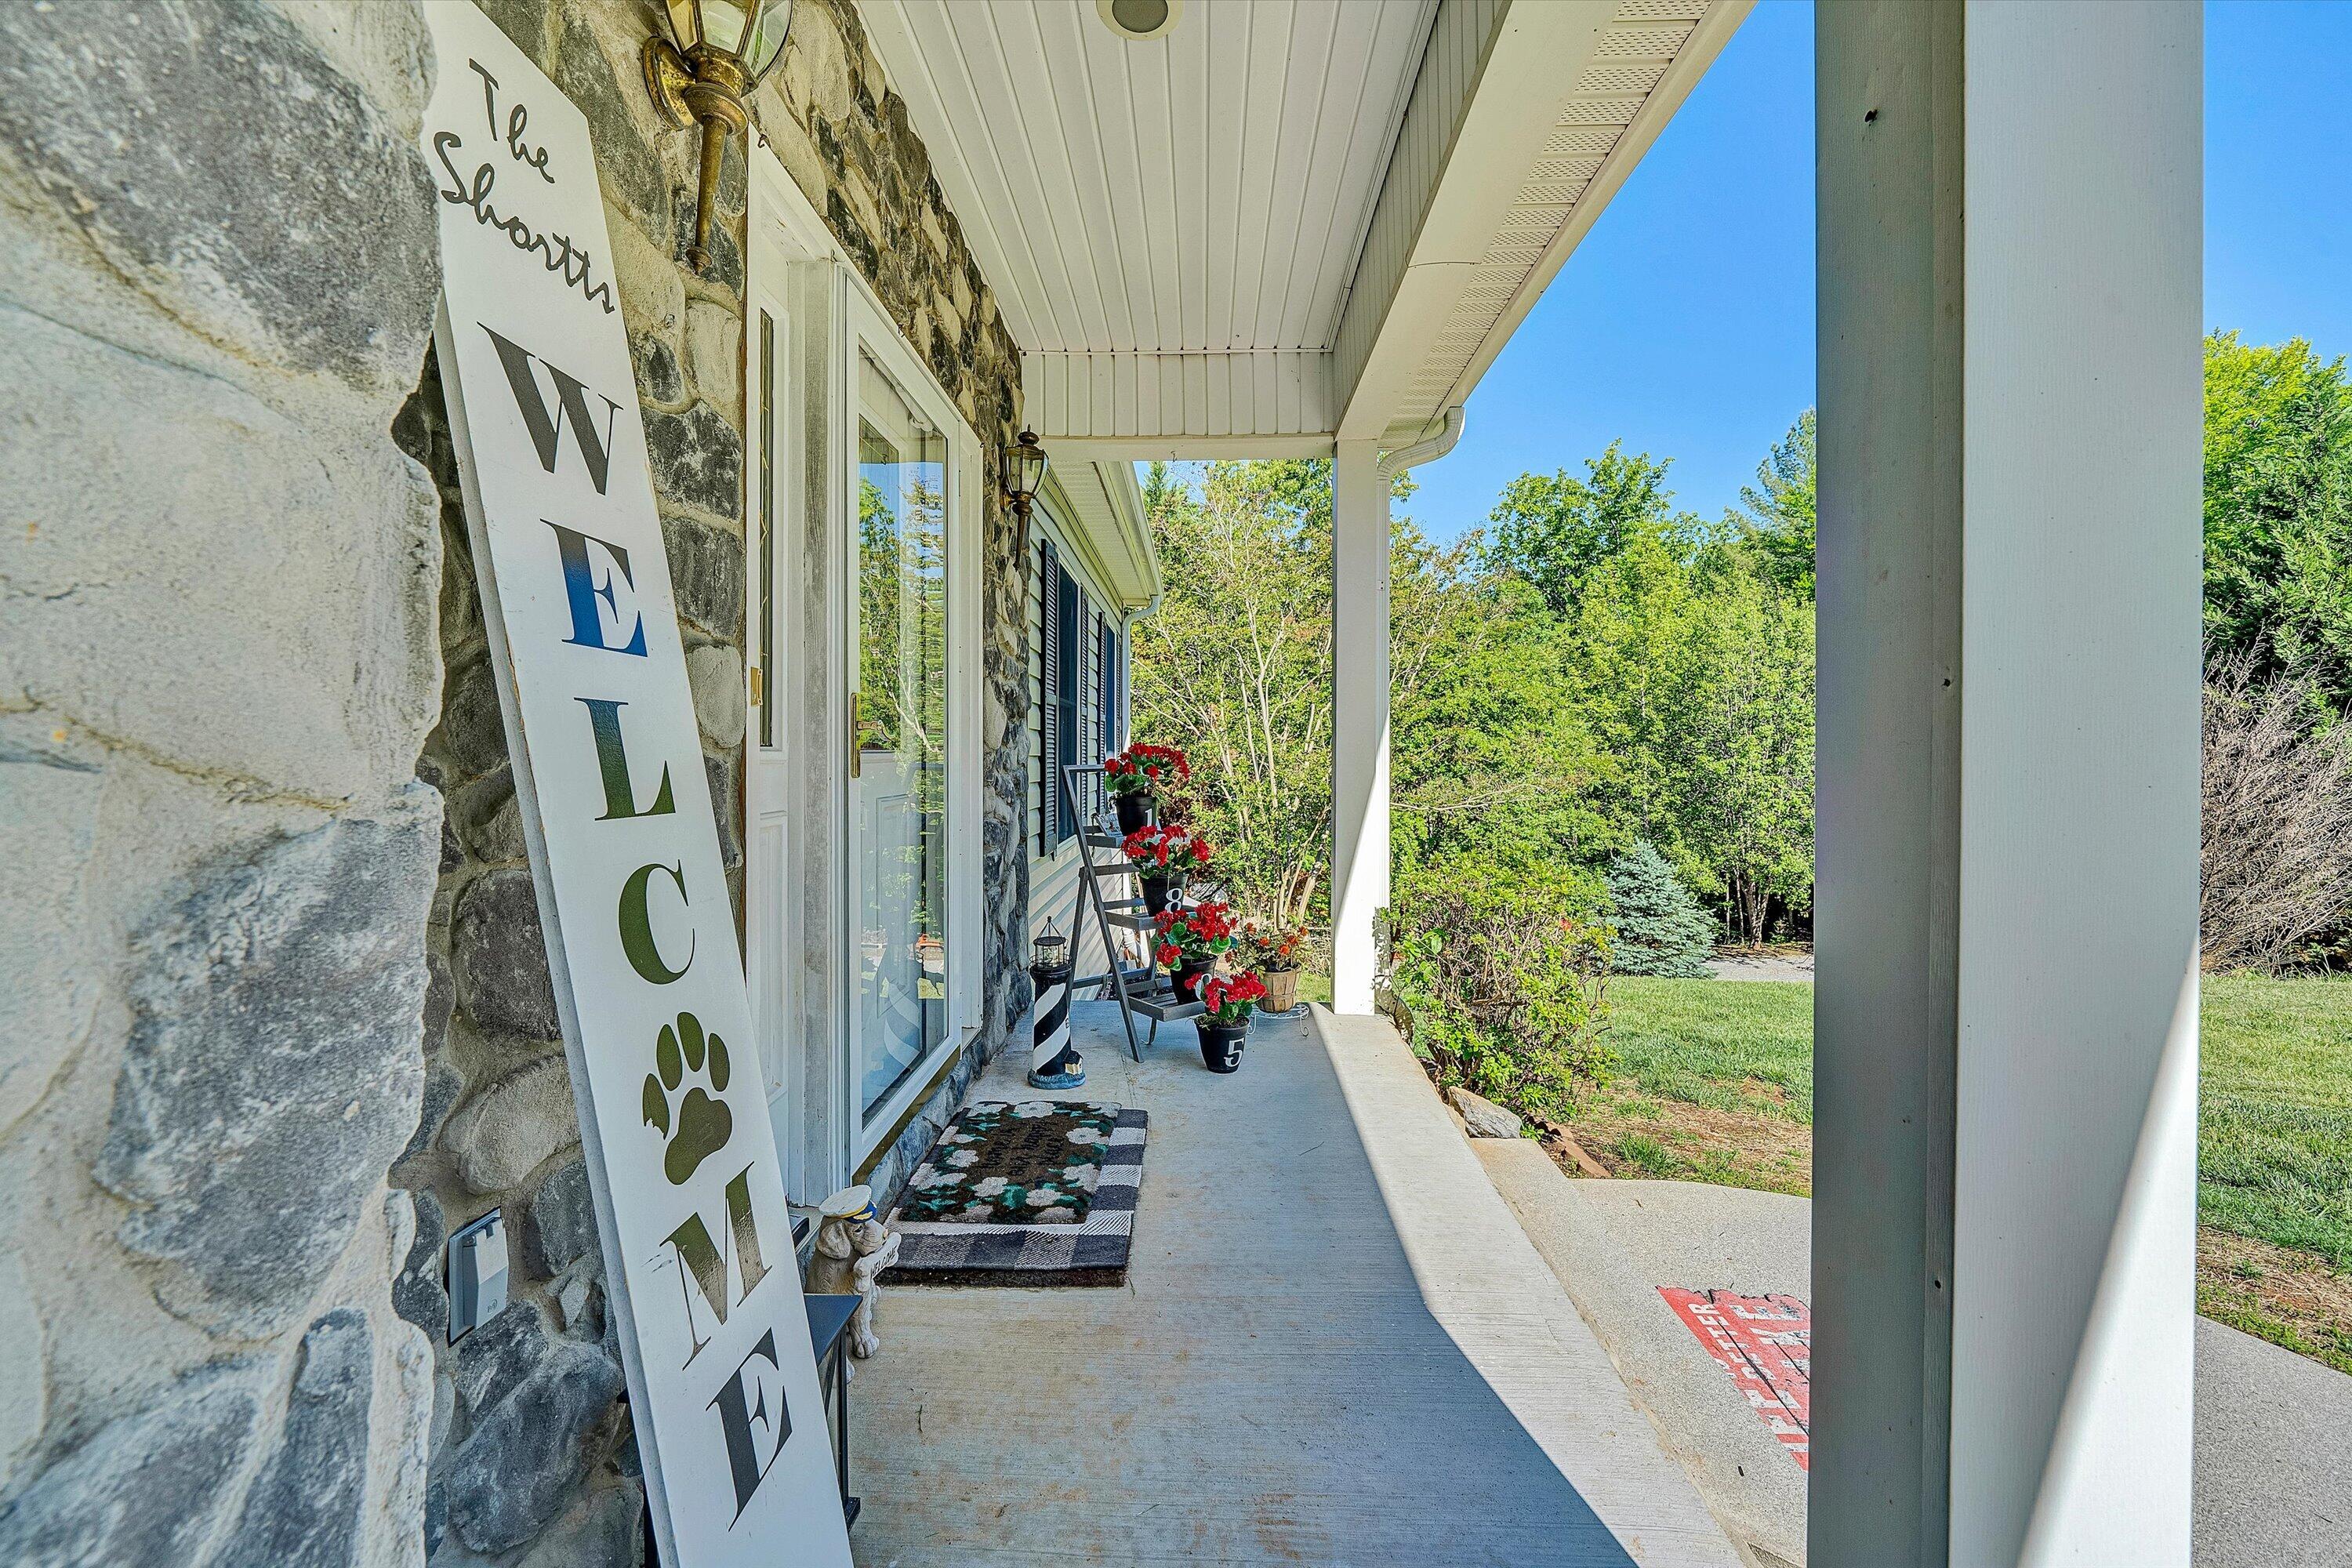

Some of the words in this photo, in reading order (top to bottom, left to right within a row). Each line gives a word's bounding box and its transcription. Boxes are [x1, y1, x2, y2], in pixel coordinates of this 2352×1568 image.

[469, 58, 555, 184] The
[434, 131, 615, 314] Shortts
[1145, 808, 1152, 827] 1
[1164, 887, 1183, 914] 8
[1224, 1037, 1245, 1067] 5
[1688, 1303, 1777, 1381] BETTER
